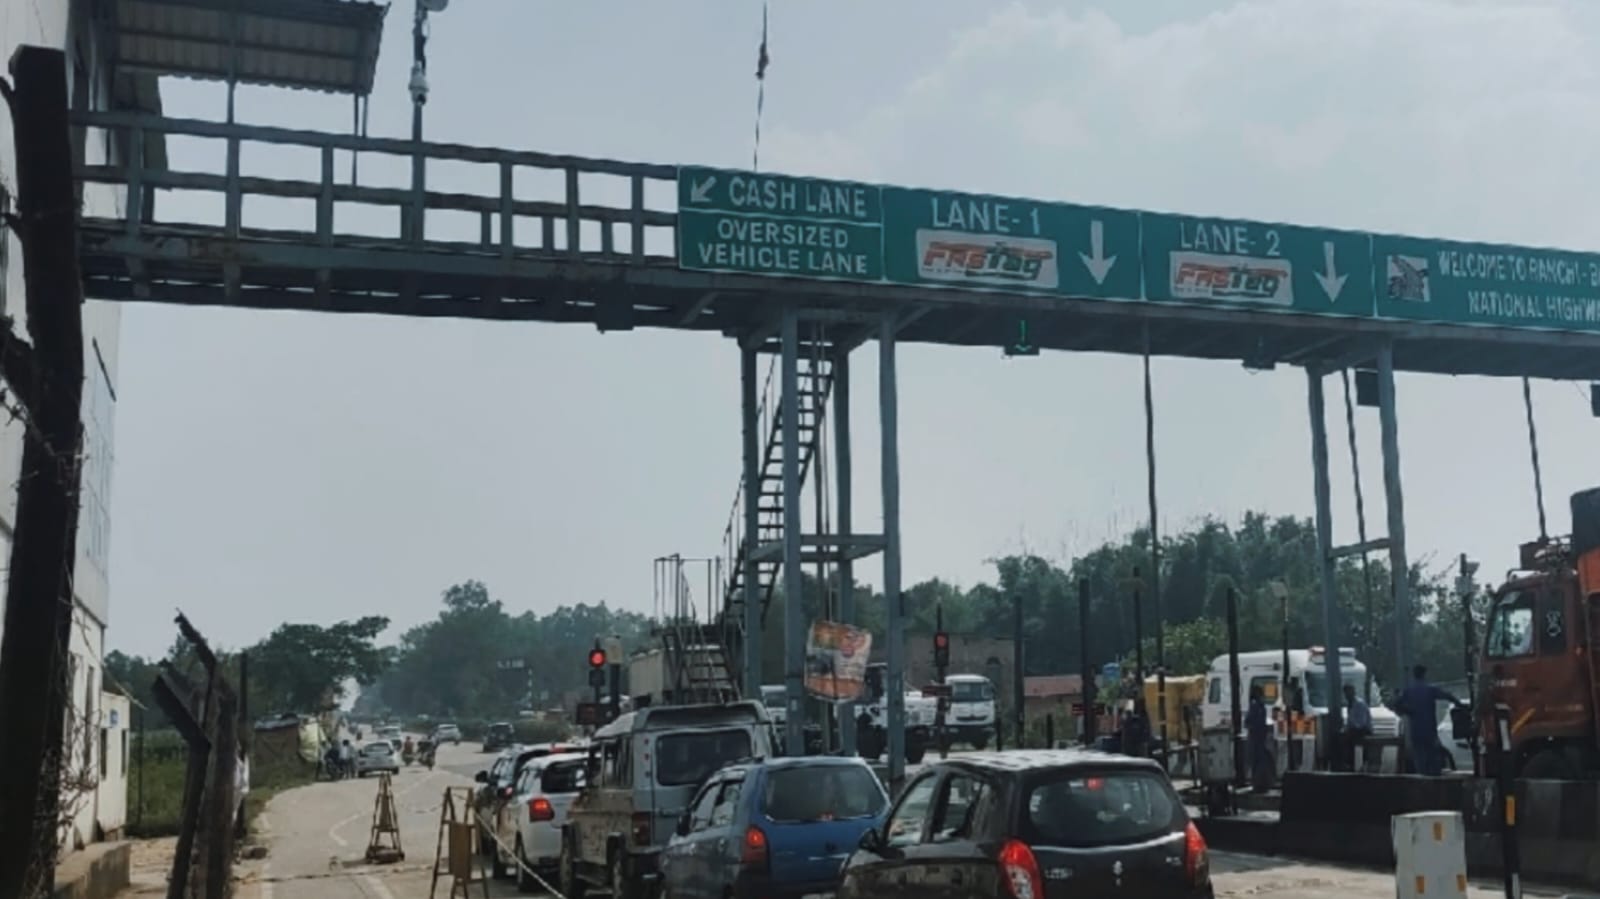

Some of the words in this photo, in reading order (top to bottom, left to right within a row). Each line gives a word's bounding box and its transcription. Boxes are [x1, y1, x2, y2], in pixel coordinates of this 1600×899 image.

[728, 175, 796, 210] CASH
[805, 183, 867, 218] LANE
[717, 218, 849, 249] OVERSIZED
[698, 243, 800, 270] VEHICLE
[808, 251, 867, 274] LANE
[1437, 250, 1506, 280] WELCOME
[1507, 254, 1527, 281] TO
[1467, 290, 1545, 318] NATIONAL
